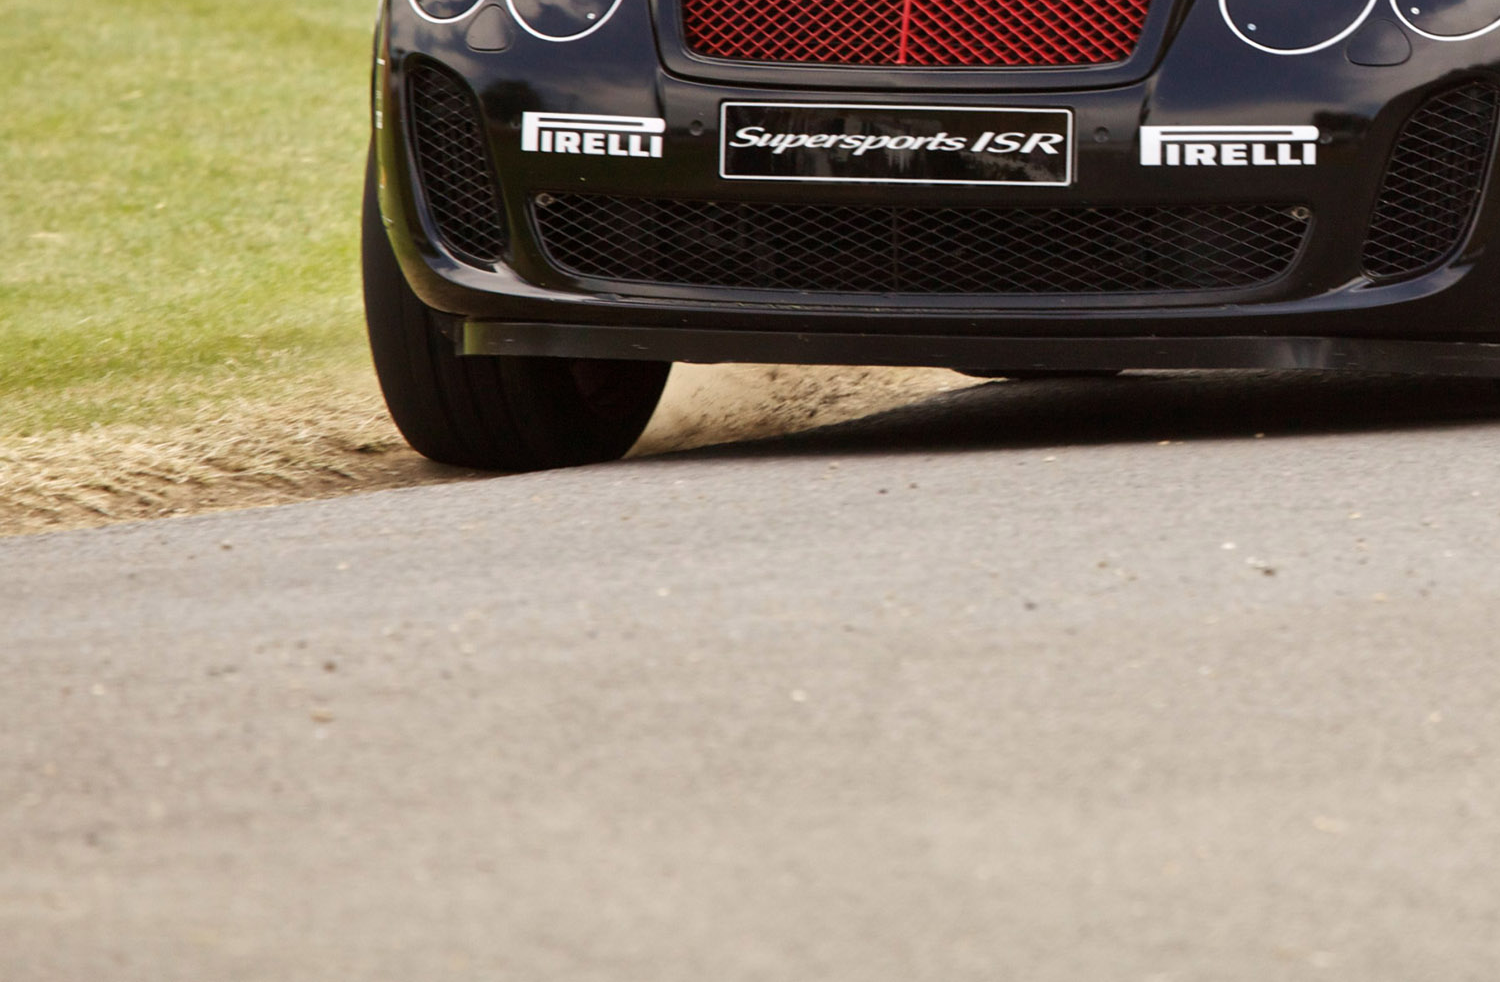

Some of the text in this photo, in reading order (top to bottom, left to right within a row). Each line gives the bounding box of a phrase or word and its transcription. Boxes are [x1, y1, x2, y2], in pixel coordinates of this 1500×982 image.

[521, 111, 666, 158] PIRELLI
[729, 126, 1064, 155] Supersports ISR
[1139, 125, 1319, 166] PIRELLI
